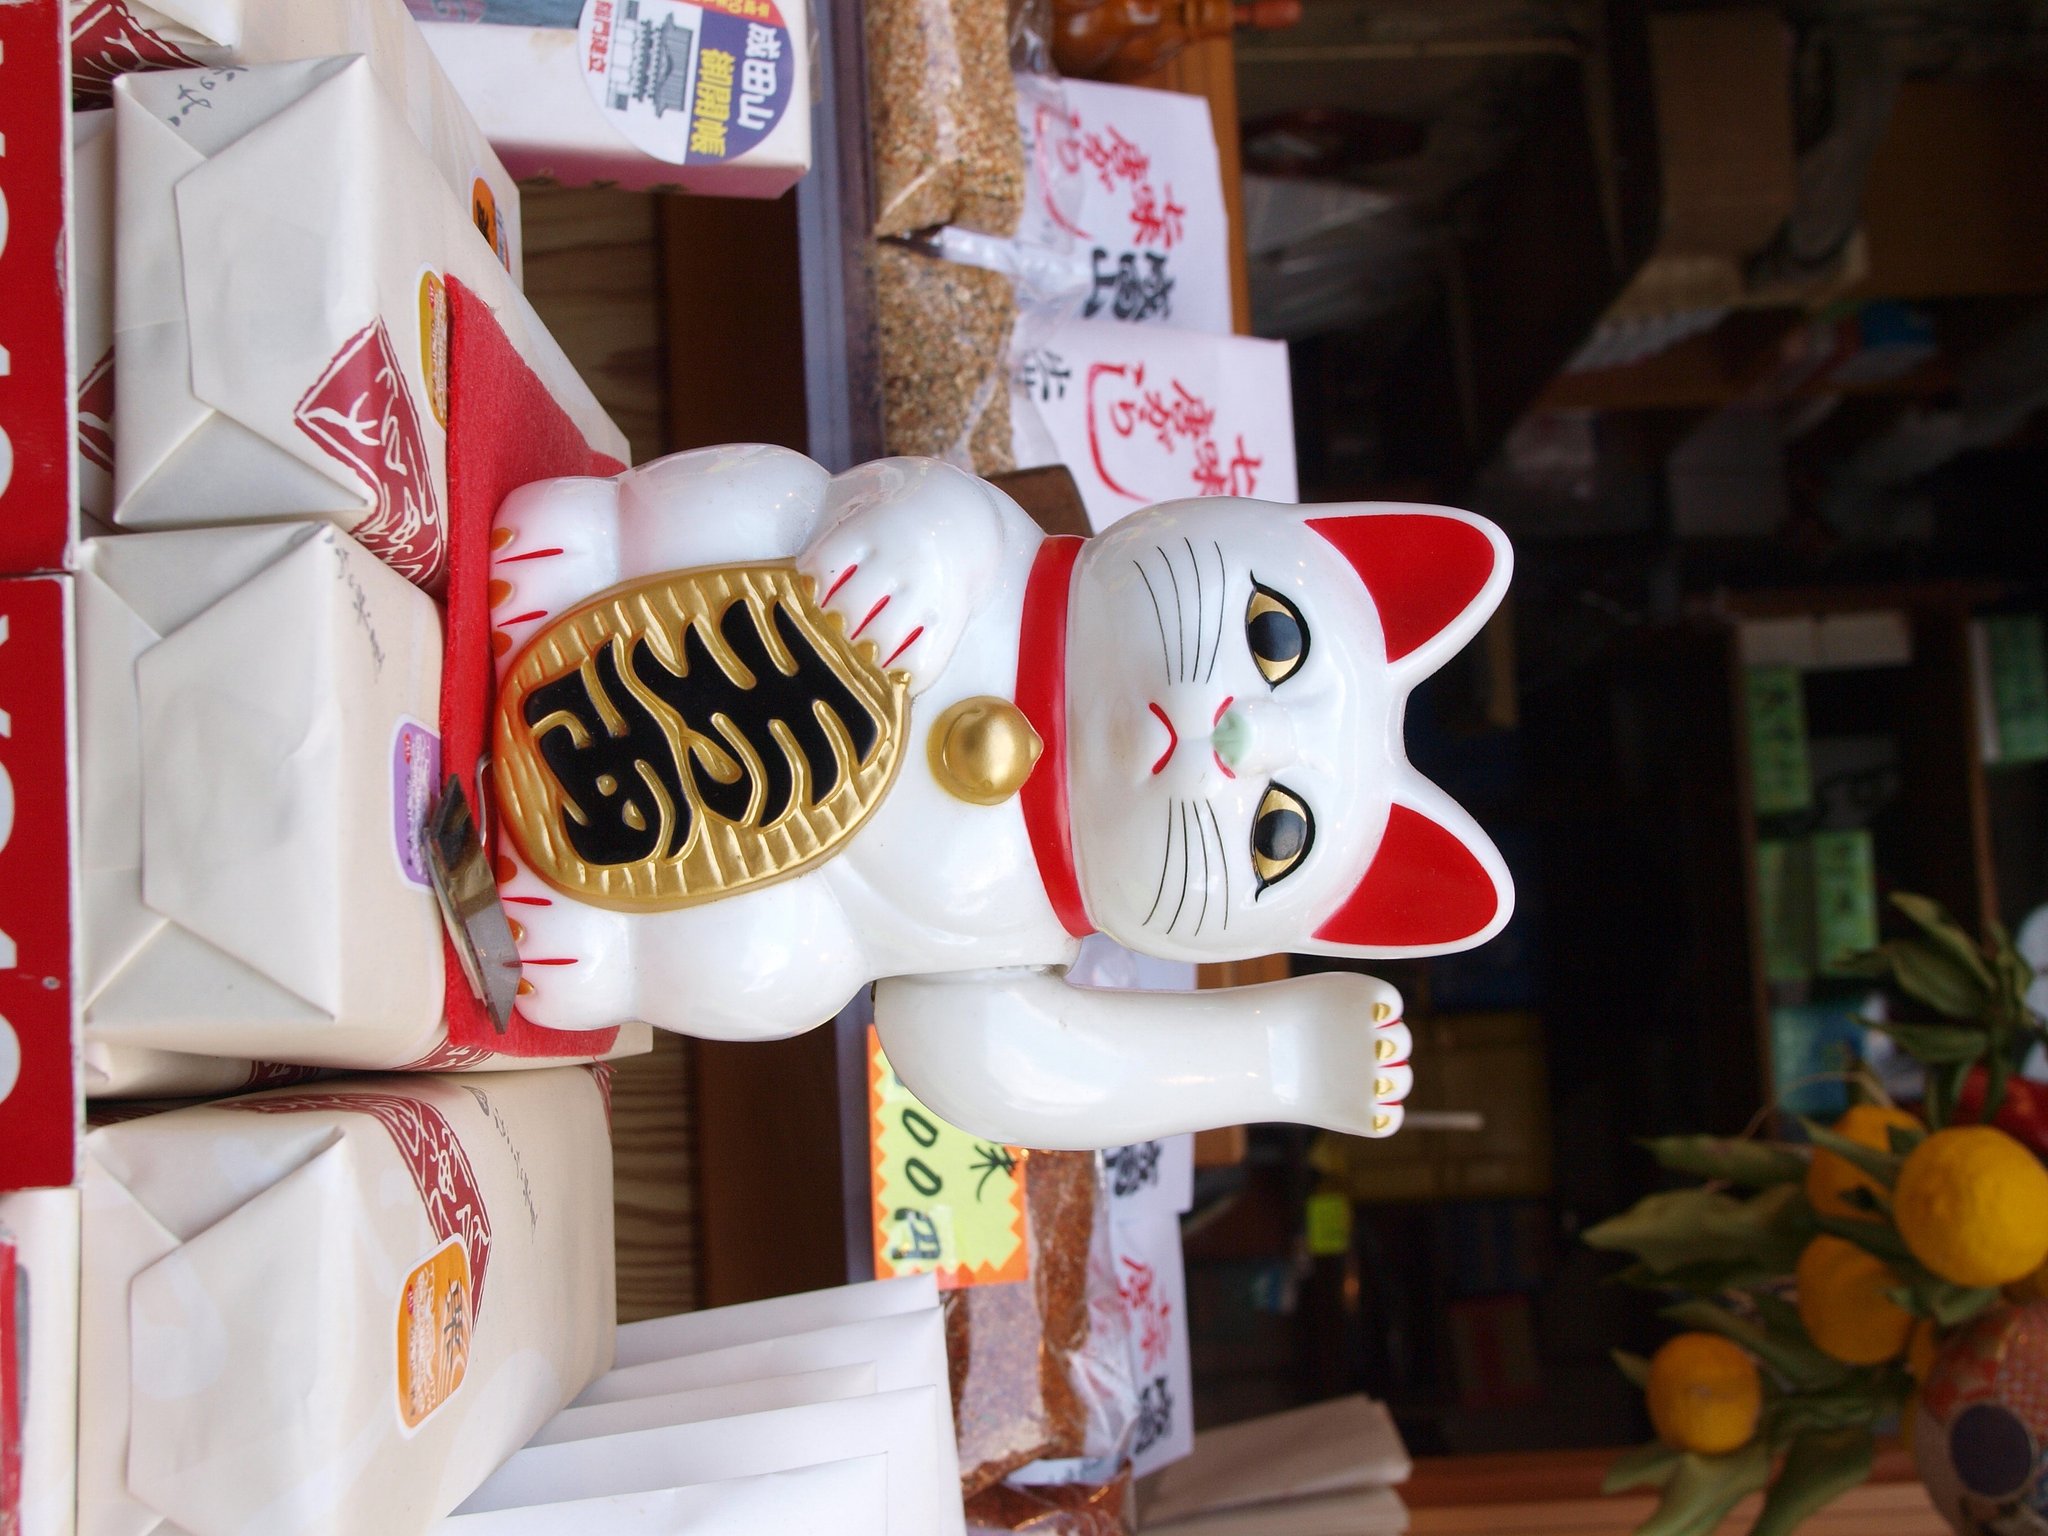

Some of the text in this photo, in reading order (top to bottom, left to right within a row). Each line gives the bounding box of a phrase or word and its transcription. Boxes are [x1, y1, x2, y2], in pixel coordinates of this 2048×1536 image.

[690, 48, 736, 158] 御開帳
[736, 22, 782, 131] 成田山
[891, 1075, 943, 1260] 00円
